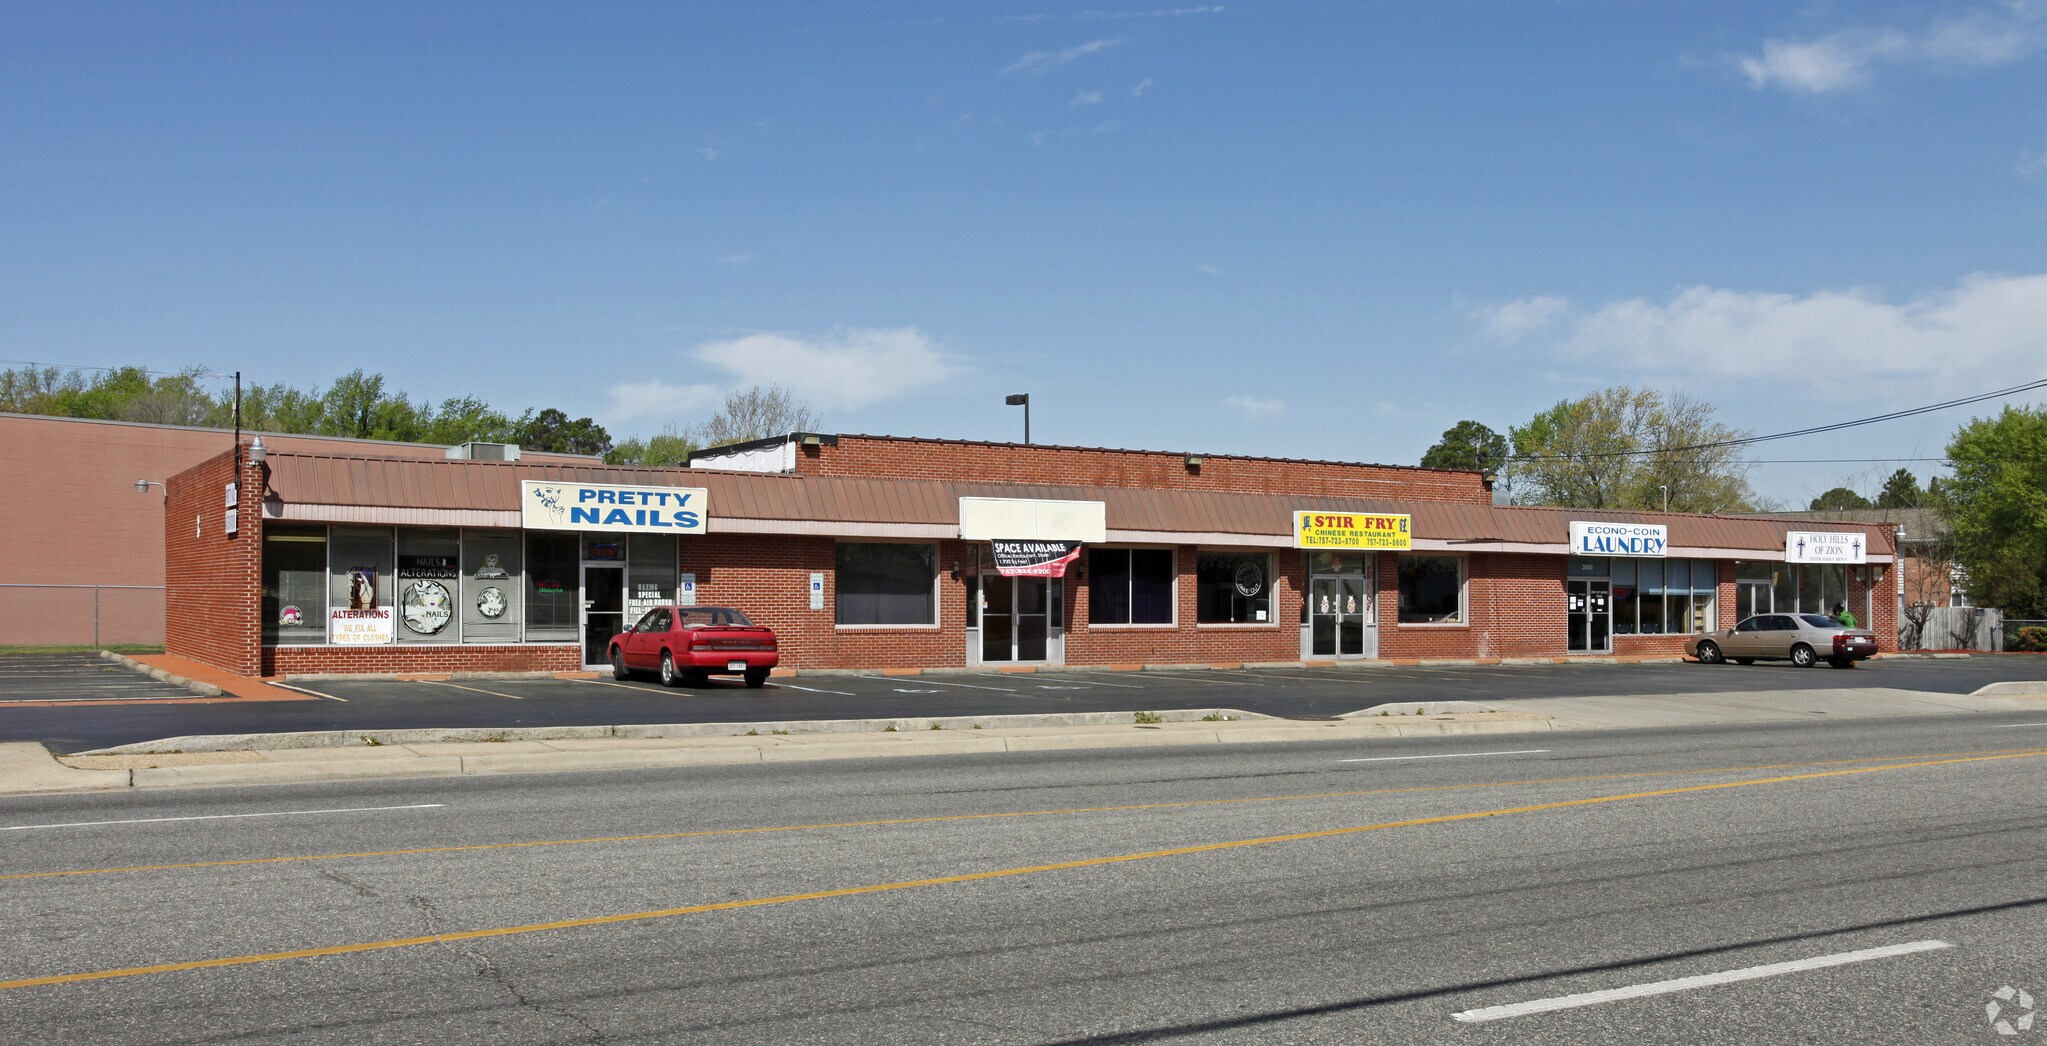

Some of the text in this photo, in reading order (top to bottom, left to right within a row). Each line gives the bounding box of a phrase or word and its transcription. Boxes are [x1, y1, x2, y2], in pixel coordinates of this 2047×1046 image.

[579, 489, 692, 507] PRETTY
[571, 507, 699, 528] NAILS
[1314, 515, 1354, 528] STIR
[1364, 517, 1396, 529] FRY
[1349, 530, 1396, 538] RESTAURANT
[1587, 526, 1660, 535] ECONO-COIN
[1810, 534, 1849, 544] HOLY HILLS
[994, 543, 1021, 553] SPACE
[1023, 543, 1066, 553] AVAILABLE
[1583, 535, 1666, 553] LAUNDRY
[1815, 546, 1843, 555] OF ZION
[417, 558, 440, 567] NAILS
[400, 568, 457, 578] ALTERATIONS
[637, 583, 658, 591] WAXING
[638, 591, 661, 599] SPECIAL
[332, 609, 390, 619] ALTERATIONS
[425, 610, 449, 618] NAILS
[343, 624, 377, 632] WE FIX ALL
[352, 633, 361, 642] OF
[363, 633, 390, 642] CLOTHES
